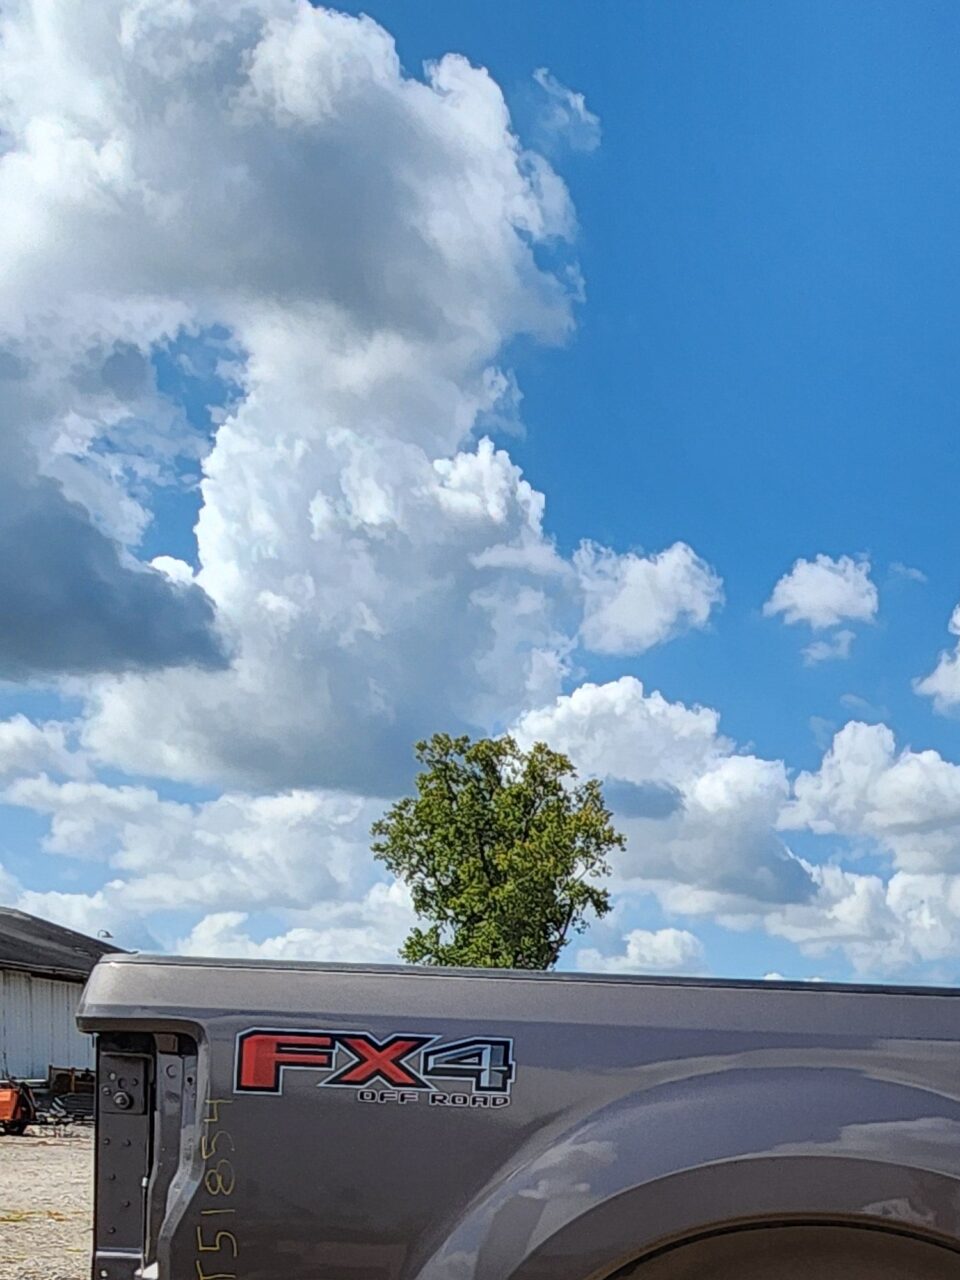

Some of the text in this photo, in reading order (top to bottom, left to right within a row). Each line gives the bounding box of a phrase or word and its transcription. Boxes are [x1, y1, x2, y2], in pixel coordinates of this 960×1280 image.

[233, 1027, 515, 1096] FX4
[357, 1089, 511, 1109] OFF ROAD
